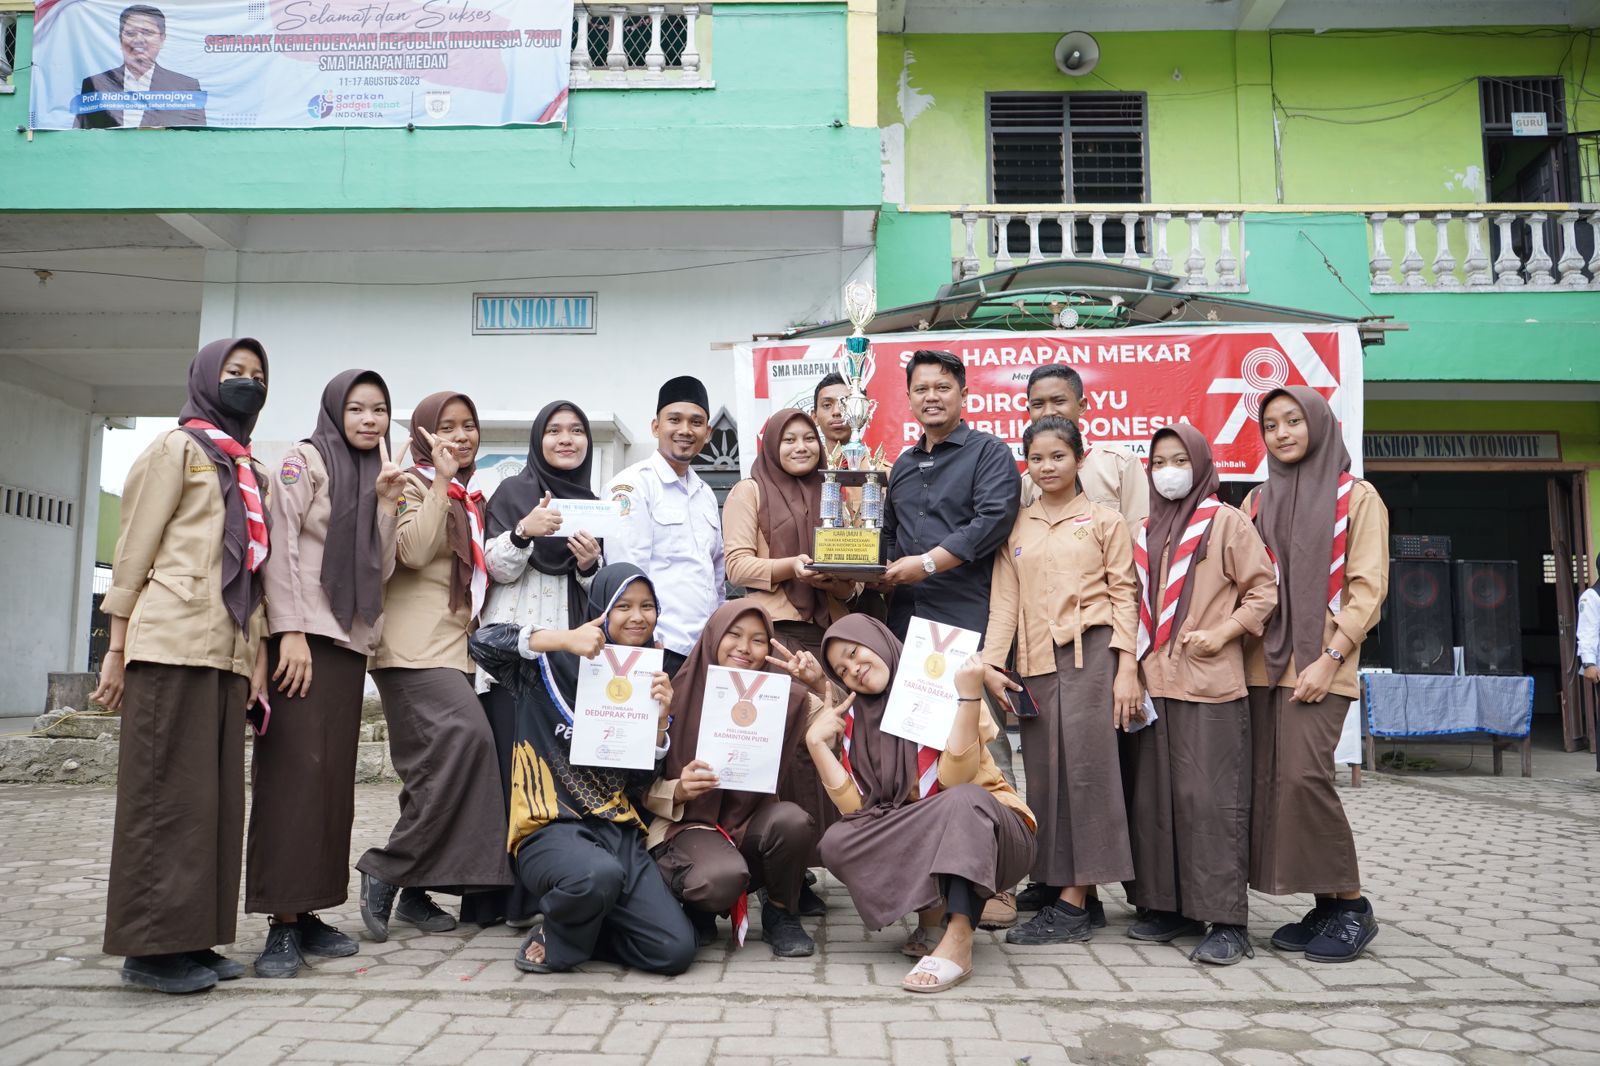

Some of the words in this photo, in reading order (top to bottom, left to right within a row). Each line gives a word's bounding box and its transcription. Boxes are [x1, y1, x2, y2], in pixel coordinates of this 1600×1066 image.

[276, 0, 373, 30] Selamat
[375, 1, 409, 21] dan
[415, 0, 491, 28] Sukses
[204, 34, 272, 52] SEMARAK
[274, 33, 376, 51] KEMERDEKAAN
[380, 32, 447, 50] REPUBLIK
[450, 30, 521, 49] INDONESIA
[524, 29, 562, 48] 78TH
[319, 56, 345, 71] SMA
[348, 55, 402, 70] HARAPAN
[405, 54, 448, 69] MEDAN
[339, 77, 362, 86] 11-17
[364, 76, 398, 86] AGUSTUS
[400, 76, 420, 86] 2023
[82, 93, 99, 103] Prof.
[102, 92, 129, 101] Ridha
[132, 91, 193, 103] Dharmajaya
[336, 101, 371, 110] gadget
[373, 101, 400, 109] sehat
[1516, 119, 1543, 127] GURU
[480, 298, 587, 328] MUSHOLAH
[963, 345, 1090, 367] HARAPAN
[1098, 343, 1191, 363] MEKAR
[772, 365, 790, 378] SMA
[792, 361, 831, 376] HARAPAN
[1364, 435, 1419, 457] RKSHOP
[1424, 435, 1466, 457] MESIN
[1469, 435, 1540, 457] OTOMOTIF
[615, 685, 623, 696] 1
[903, 680, 927, 693] TARIAN
[928, 687, 953, 700] DAERAH
[585, 709, 625, 719] DEDUPRAK
[627, 712, 648, 720] PUTRI
[741, 708, 748, 719] 3
[555, 723, 573, 740] PE
[713, 732, 750, 741] BADMINTON
